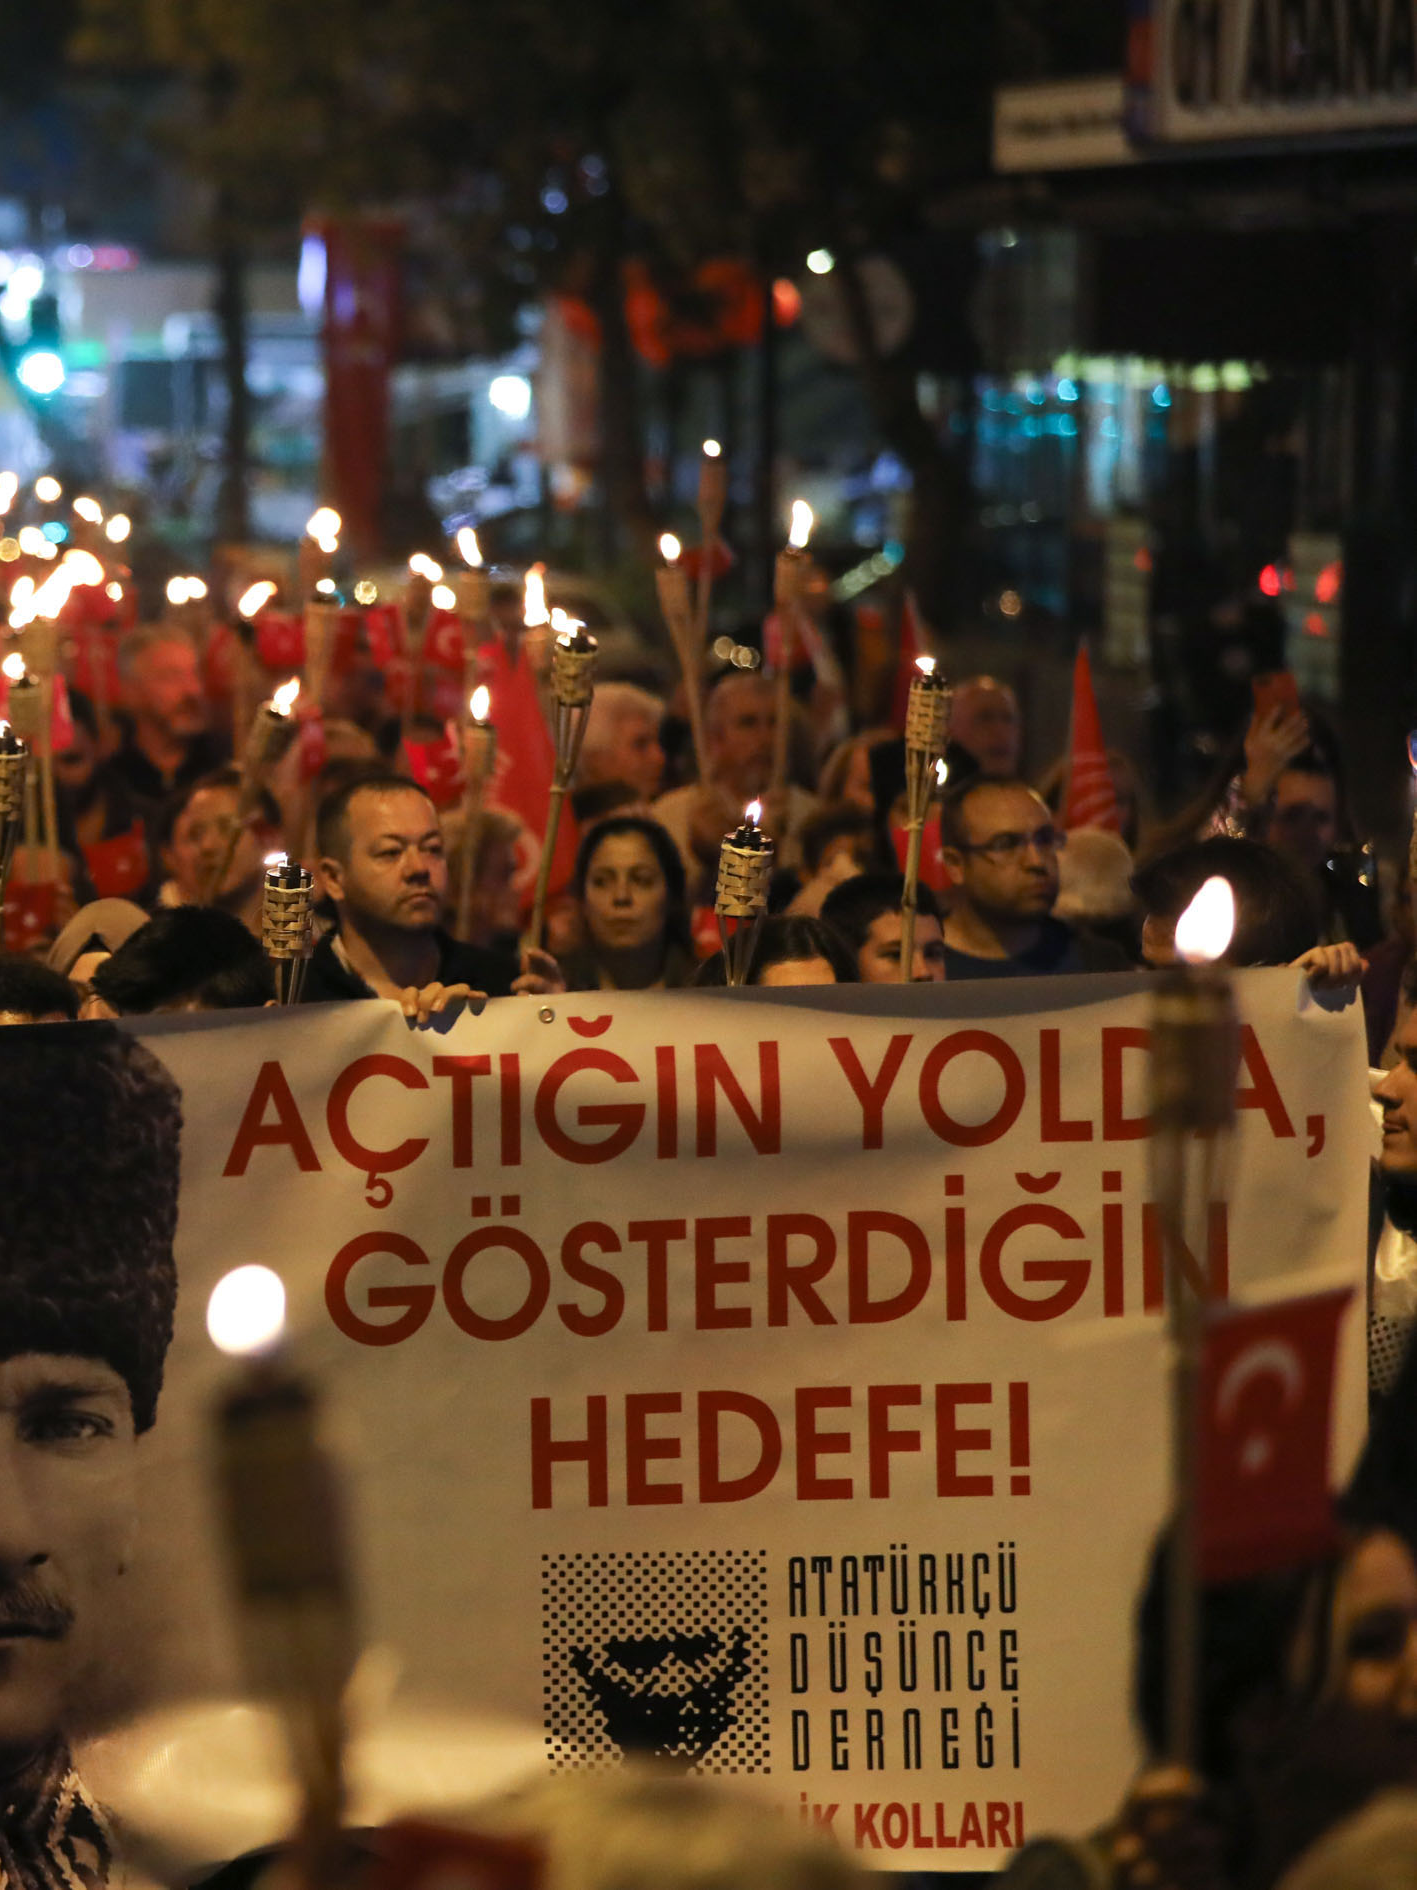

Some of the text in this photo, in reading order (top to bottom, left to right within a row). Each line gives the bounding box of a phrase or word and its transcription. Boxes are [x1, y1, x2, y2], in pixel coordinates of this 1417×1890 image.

[222, 1014, 782, 1209] AÇTIĞIN
[324, 1170, 1229, 1347] GÖSTERDİĞİN
[530, 1381, 1031, 1510] HEDEFE!
[788, 1541, 1018, 1619] ATATÜRKÇÜ
[789, 1620, 1019, 1698] DÜŞÜNCE
[791, 1695, 1022, 1771] DERNEĞİ
[853, 1801, 1025, 1850] KOLLARI
